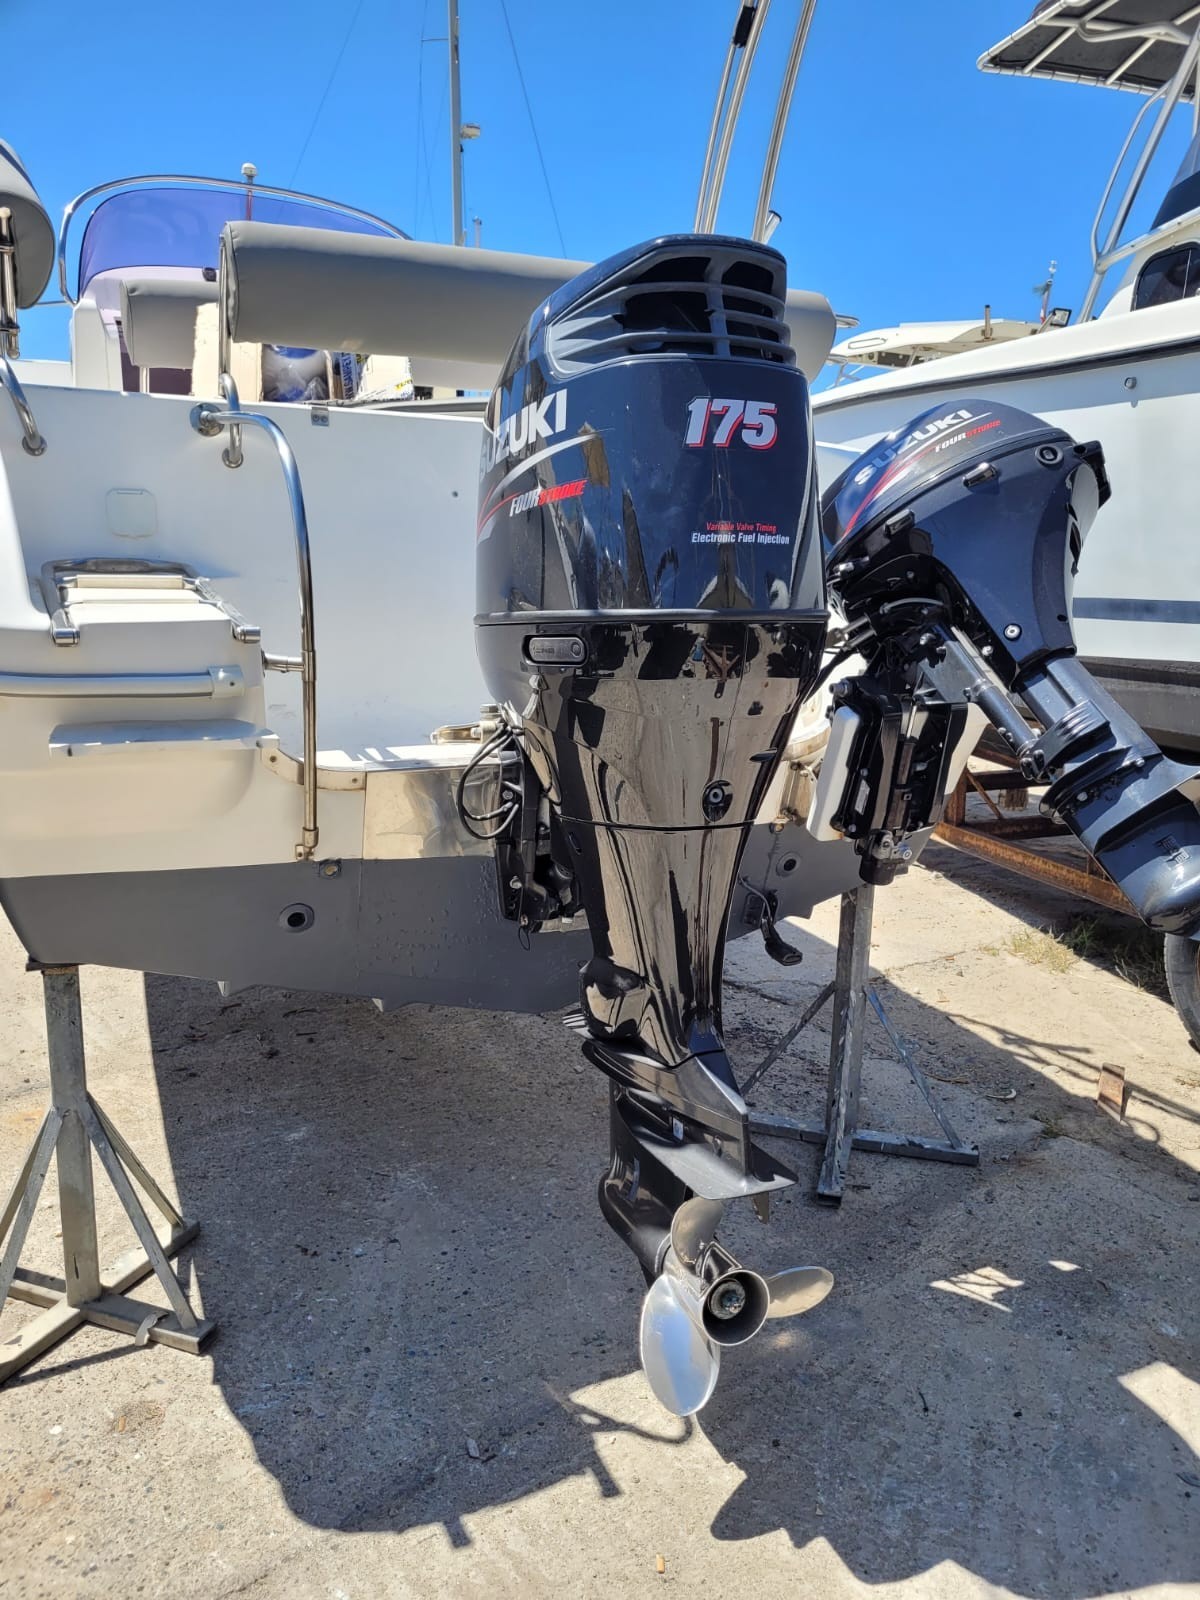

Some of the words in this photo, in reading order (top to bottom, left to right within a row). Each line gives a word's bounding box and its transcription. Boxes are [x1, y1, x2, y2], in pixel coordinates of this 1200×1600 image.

[685, 398, 778, 450] 175
[854, 409, 974, 485] SUZUKI
[691, 532, 736, 543] Electronic
[737, 532, 756, 543] Fuel
[757, 532, 790, 545] Injection
[706, 521, 735, 531] Variable
[736, 522, 754, 531] Valve
[755, 523, 777, 534] Timing
